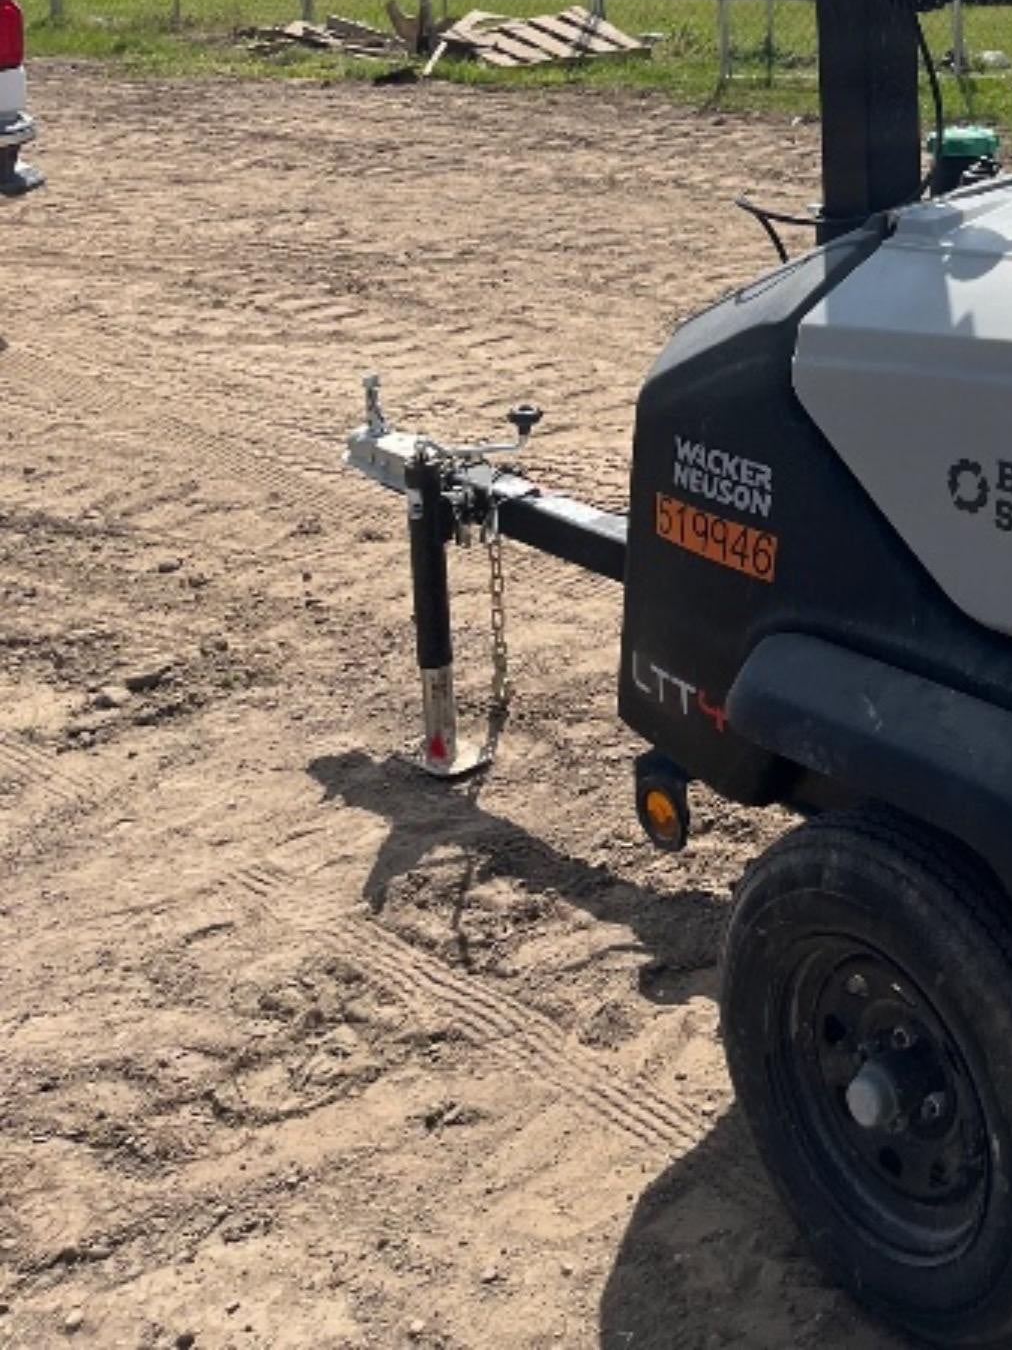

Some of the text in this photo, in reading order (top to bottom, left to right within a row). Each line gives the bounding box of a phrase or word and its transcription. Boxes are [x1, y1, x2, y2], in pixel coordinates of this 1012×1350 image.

[674, 434, 773, 491] WACKER
[674, 462, 773, 517] NEUSON
[659, 499, 773, 574] 519946
